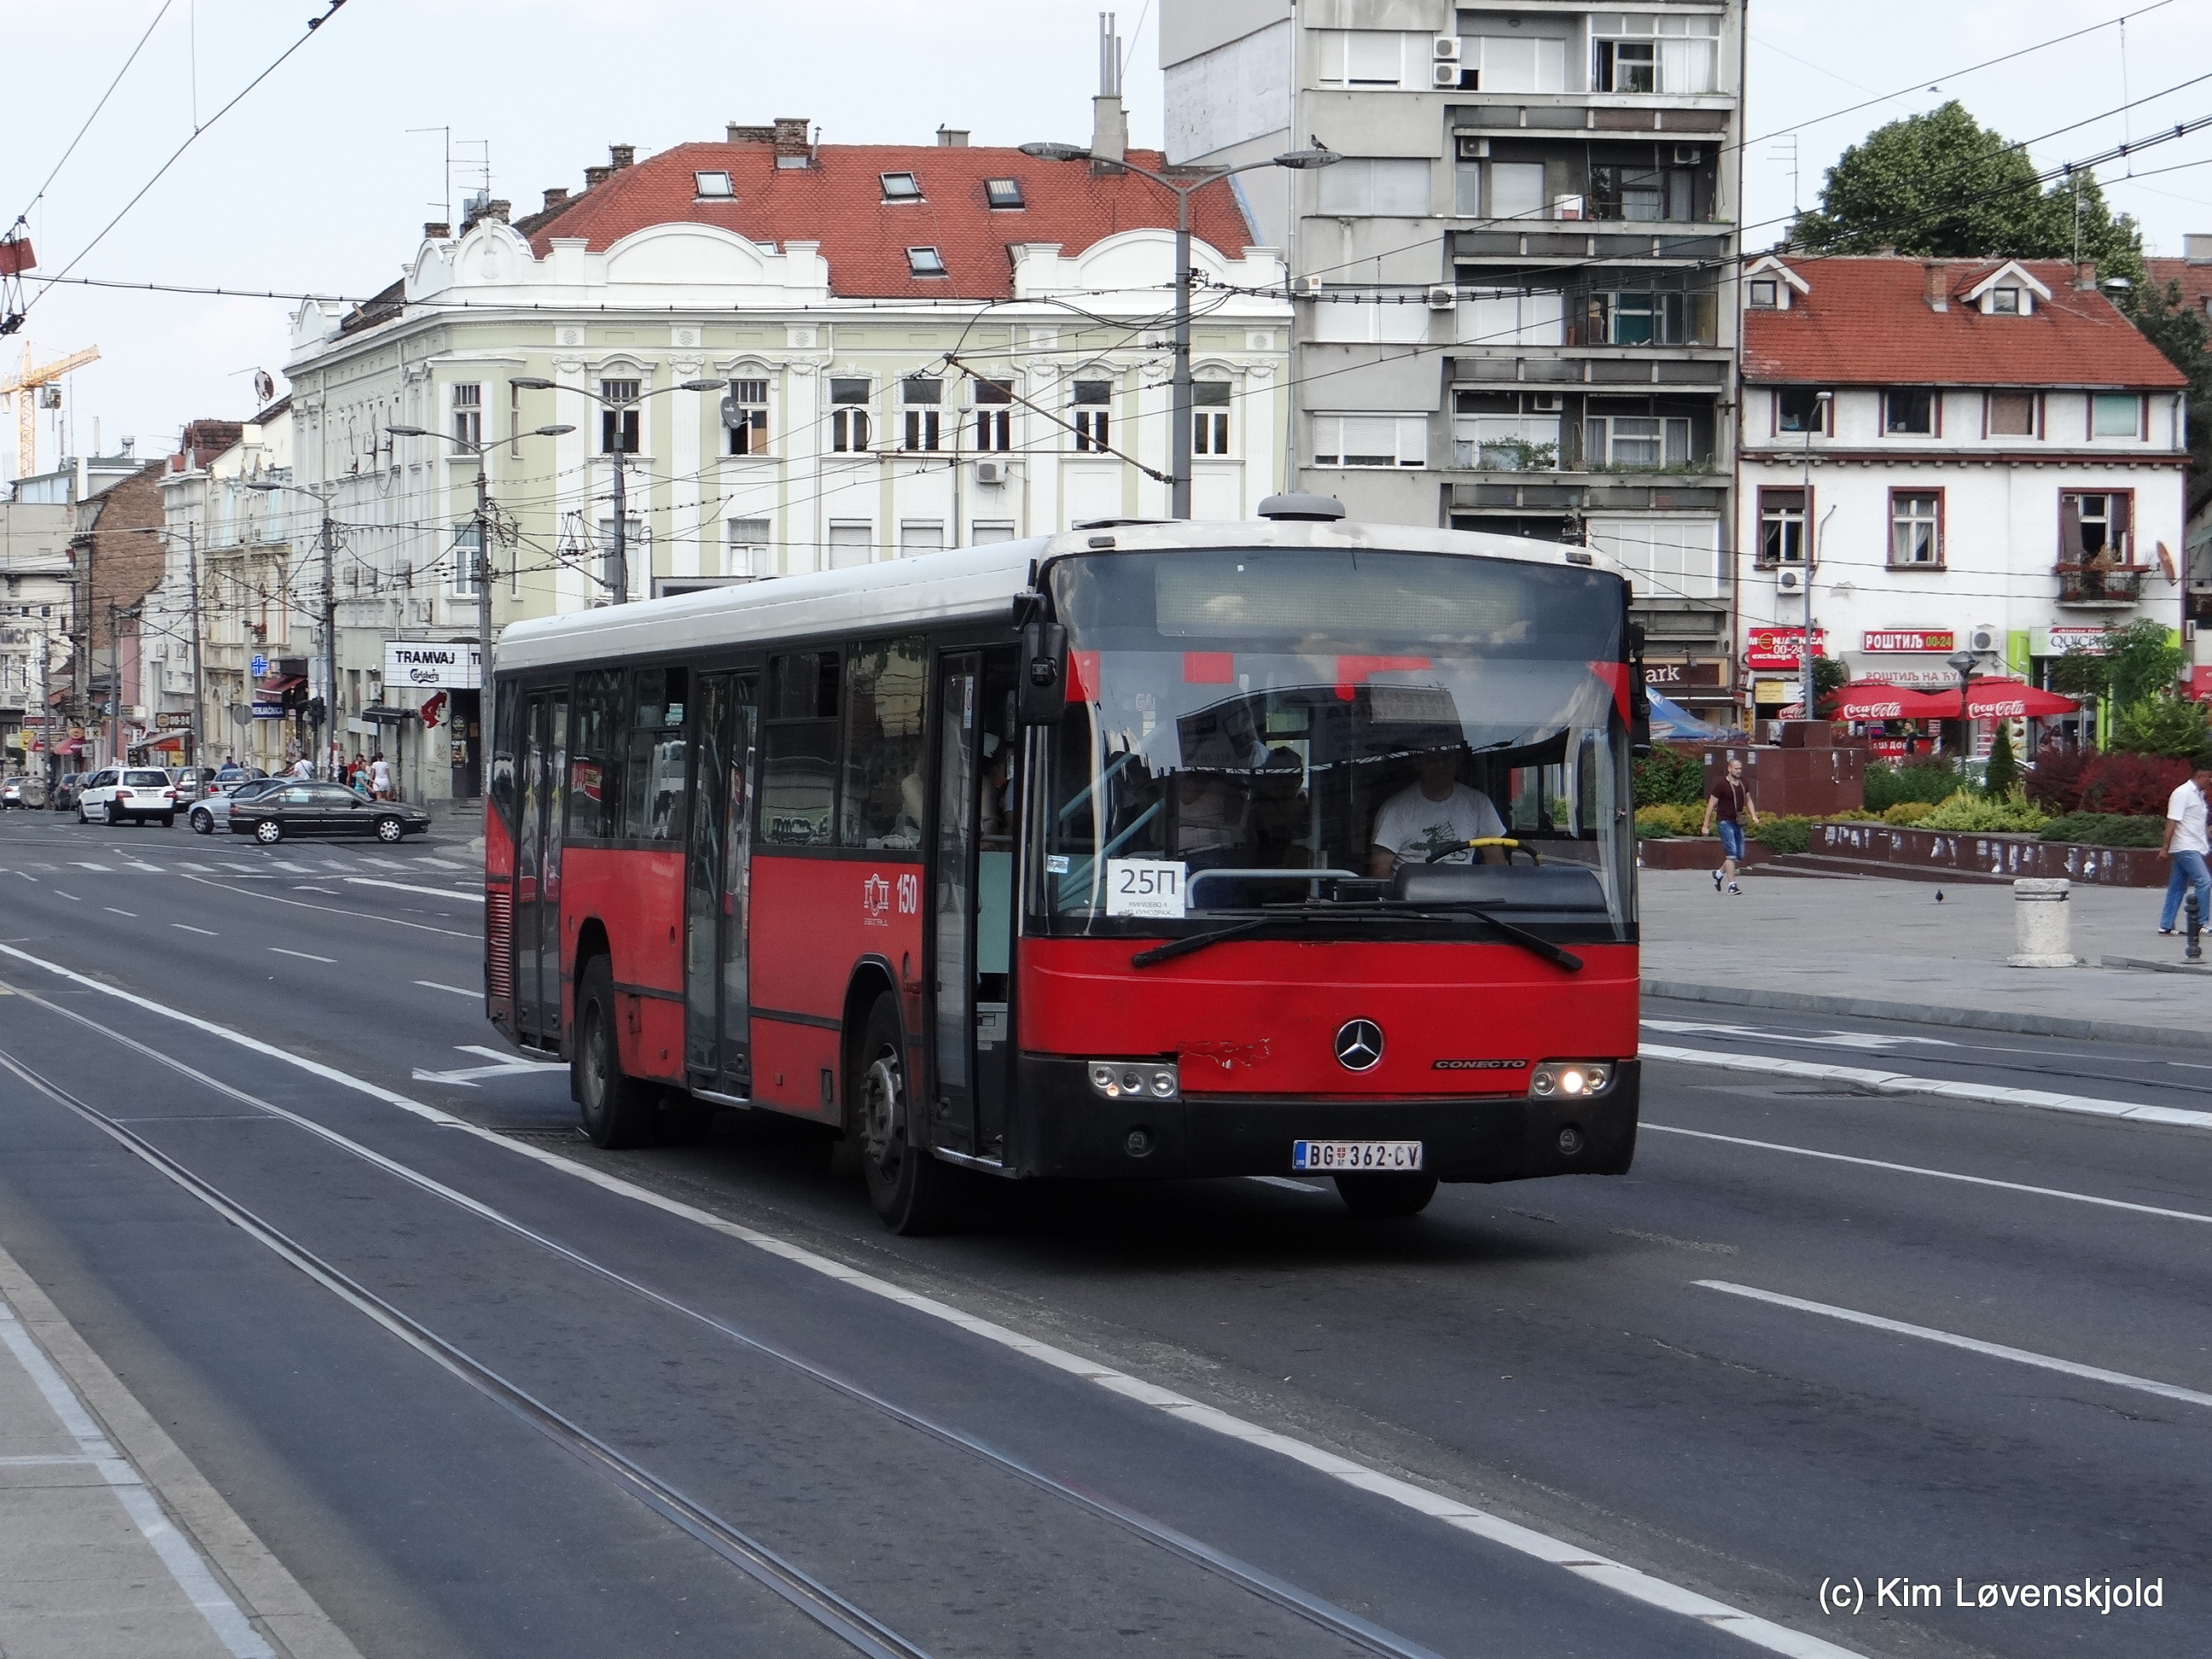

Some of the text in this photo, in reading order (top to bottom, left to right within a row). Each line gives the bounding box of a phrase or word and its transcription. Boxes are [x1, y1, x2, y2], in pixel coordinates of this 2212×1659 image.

[1866, 634, 1923, 649] РОШТИЉ
[396, 650, 455, 665] TRAMVAJ
[1752, 652, 1792, 661] exchange
[1773, 645, 1803, 655] 00-24
[1644, 665, 1680, 683] ark
[1923, 672, 1939, 681] НА
[1121, 869, 1175, 894] 25П
[897, 874, 917, 914] 150
[1435, 1060, 1526, 1068] CONECTO
[1310, 1145, 1333, 1167] BG
